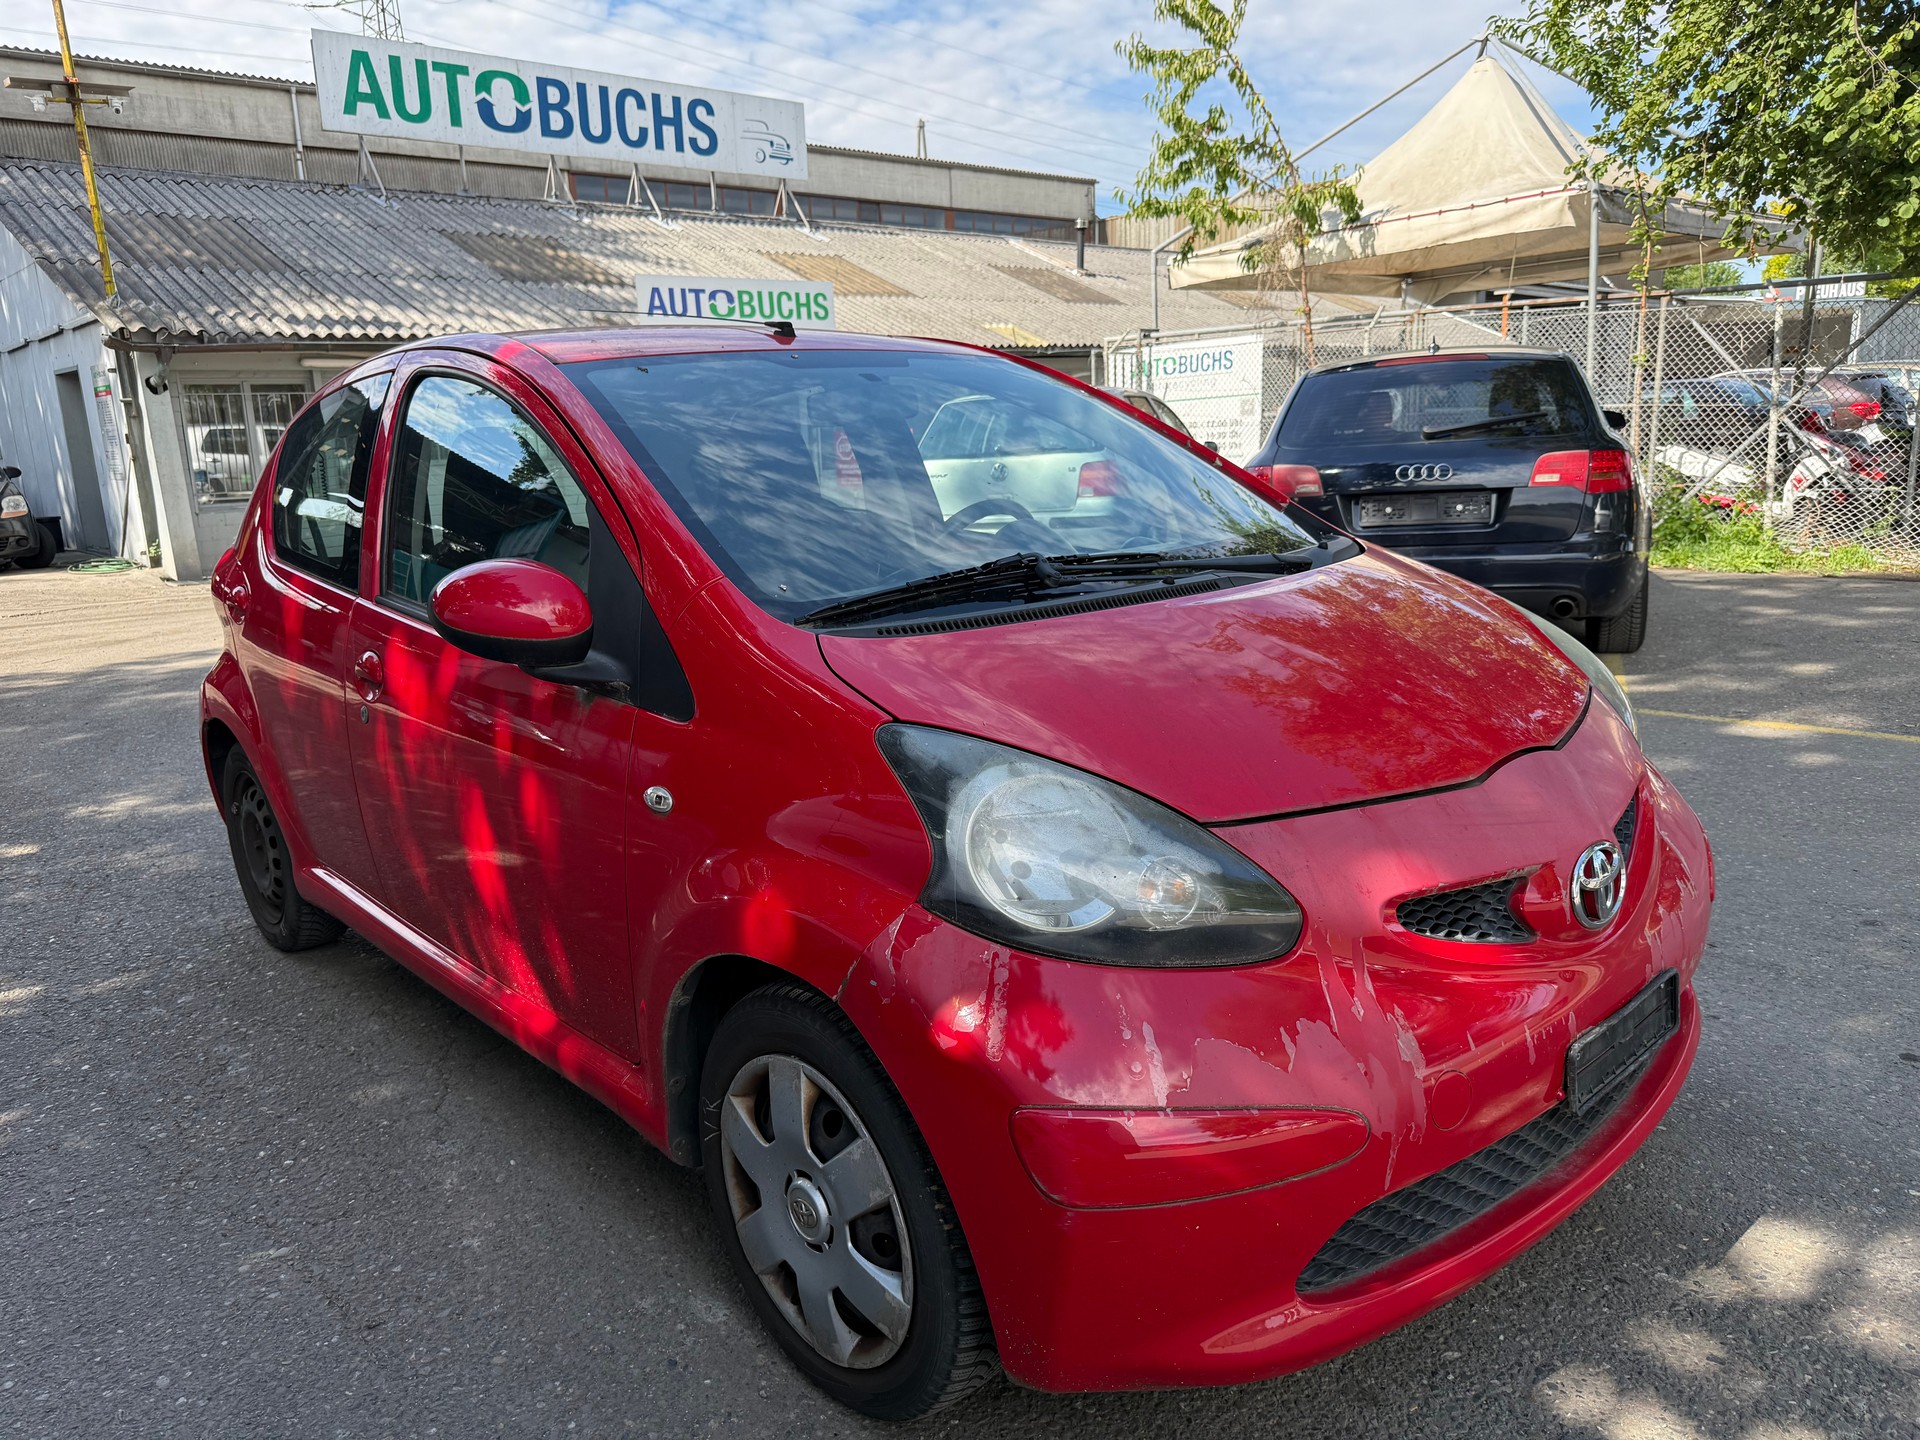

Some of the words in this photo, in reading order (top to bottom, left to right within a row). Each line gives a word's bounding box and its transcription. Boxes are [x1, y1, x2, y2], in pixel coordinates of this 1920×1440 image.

[342, 49, 718, 156] AUTOBUCHS
[648, 287, 829, 321] AUTOBUCHS
[1131, 350, 1234, 379] UTOBUCHS
